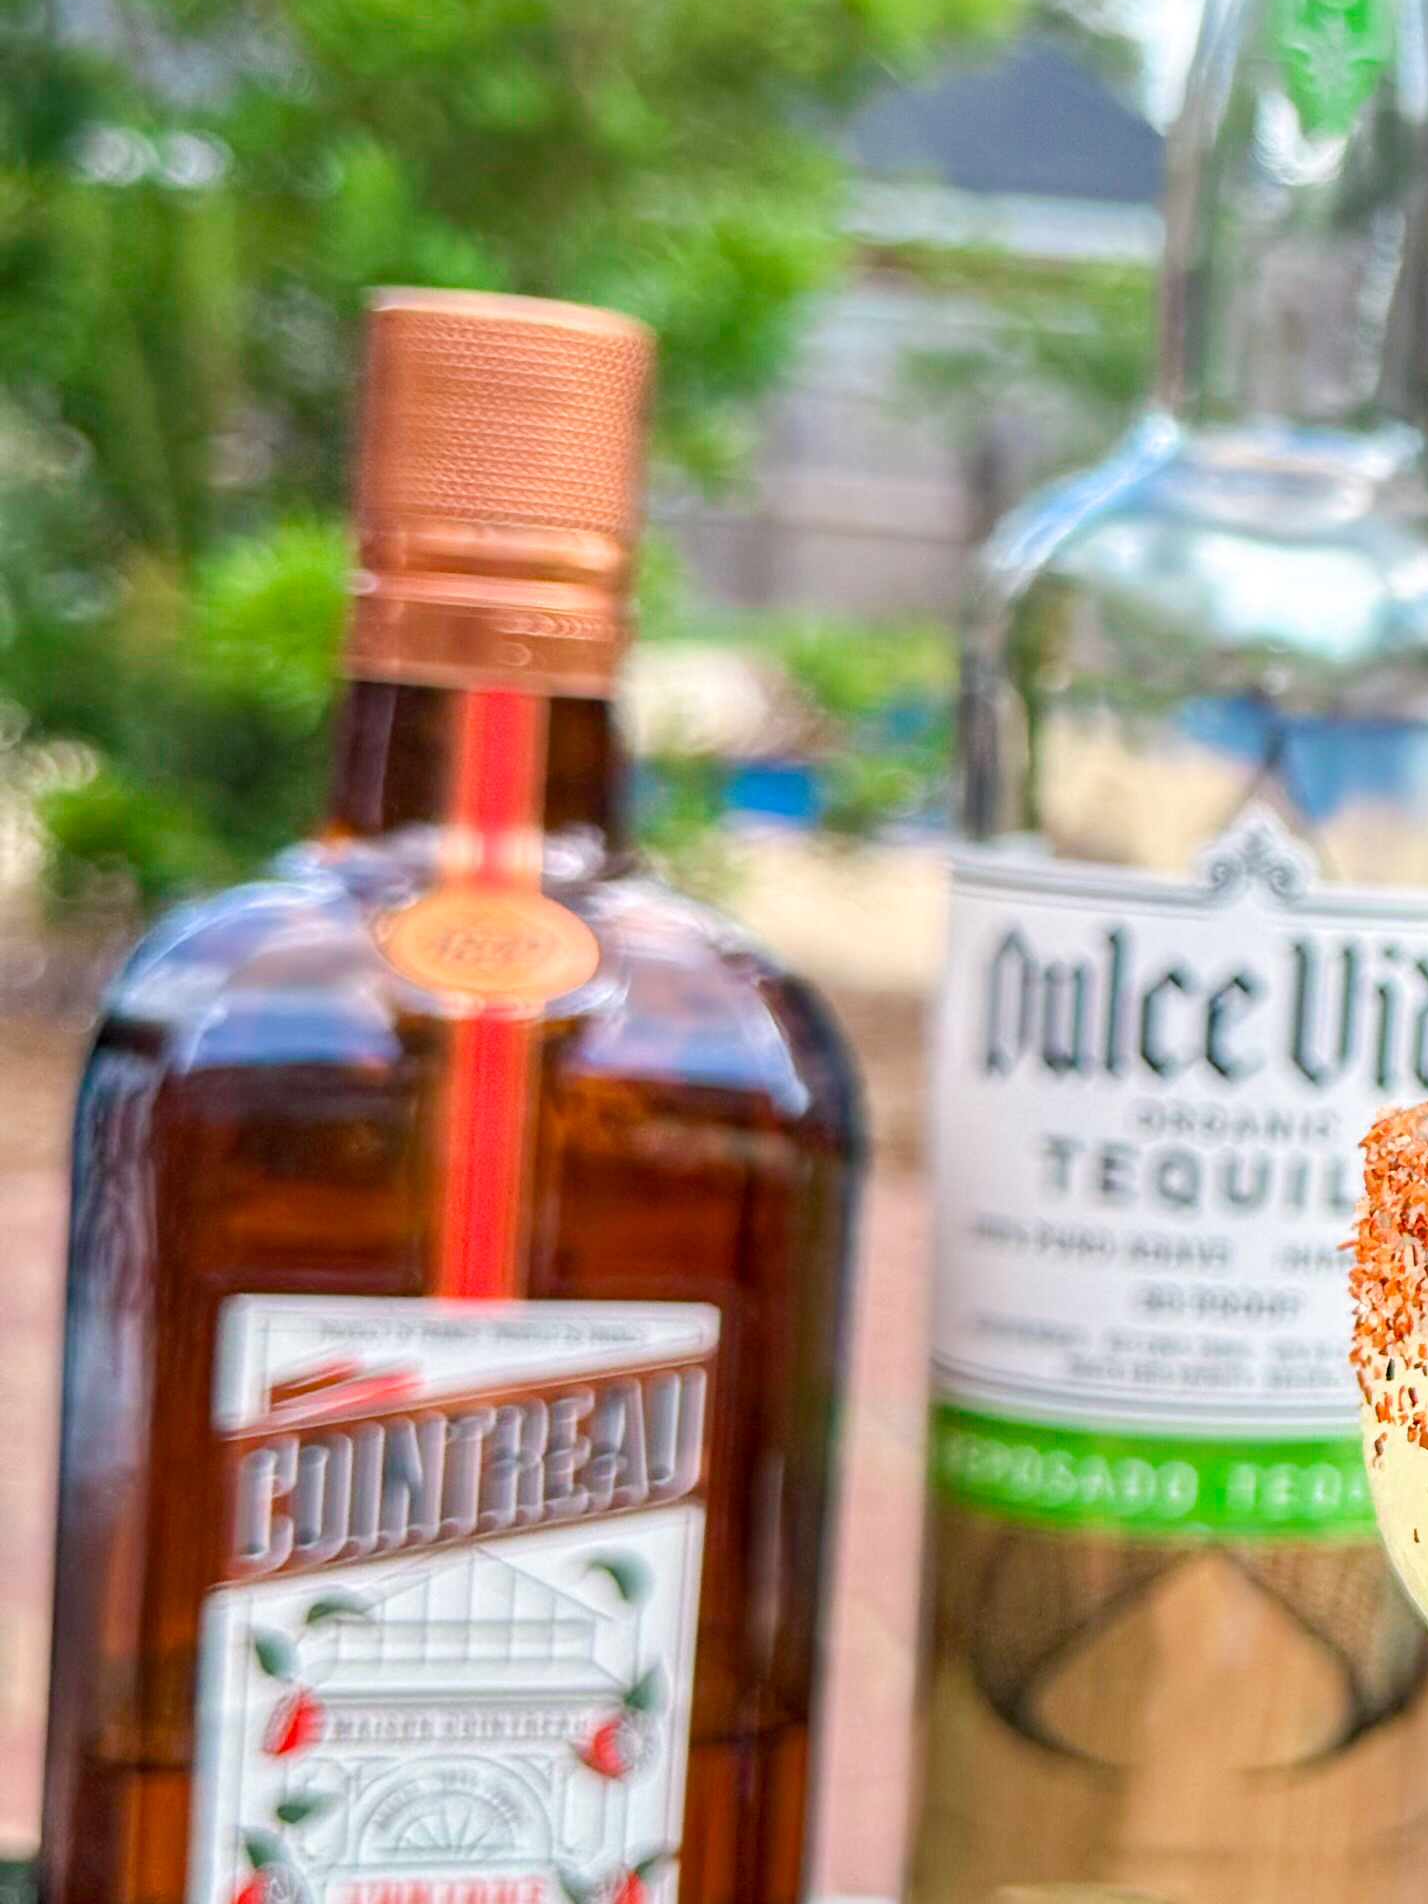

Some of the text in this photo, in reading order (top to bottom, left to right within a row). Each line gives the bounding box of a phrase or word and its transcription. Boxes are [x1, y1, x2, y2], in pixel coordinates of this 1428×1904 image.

[976, 922, 1265, 1085] Dulce
[1043, 1138, 1360, 1211] TEQUIL
[1136, 1097, 1340, 1138] ORGANIC
[235, 1367, 707, 1573] COINTREAU
